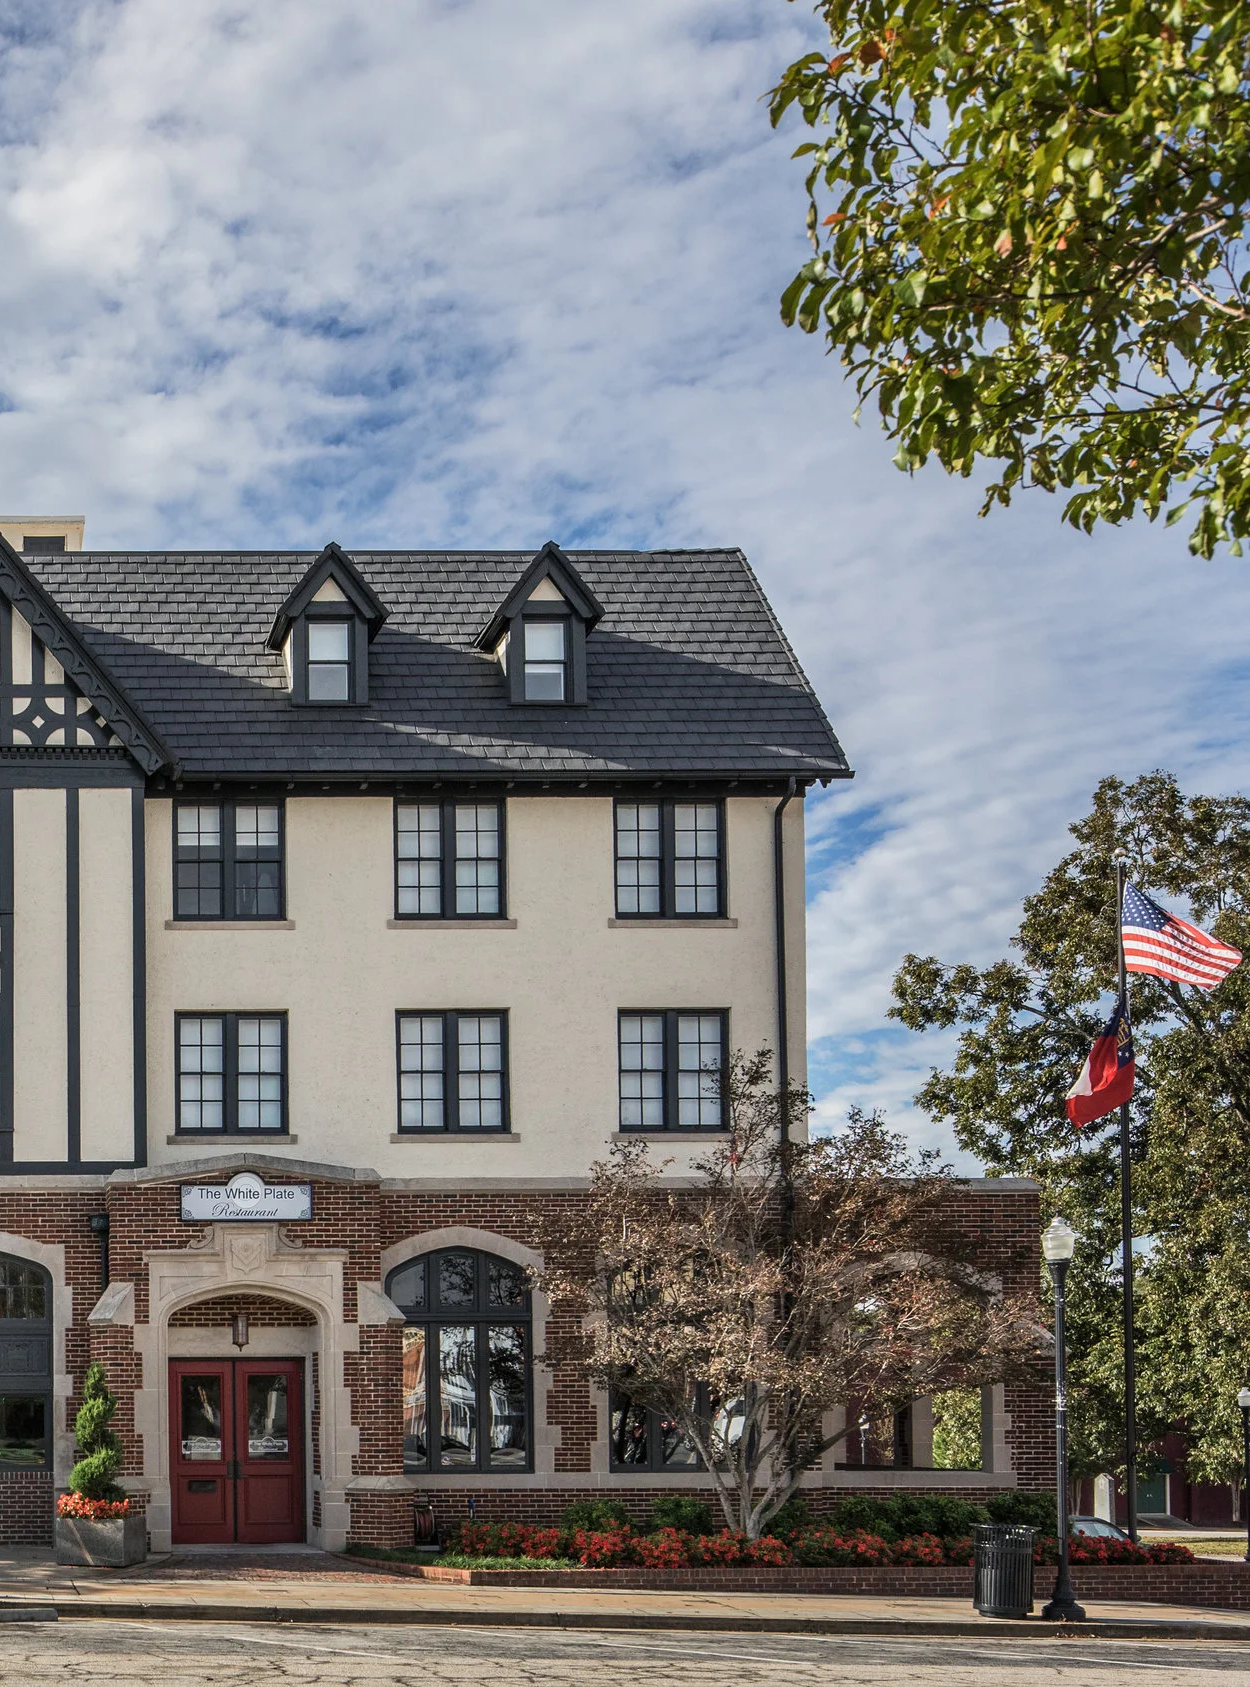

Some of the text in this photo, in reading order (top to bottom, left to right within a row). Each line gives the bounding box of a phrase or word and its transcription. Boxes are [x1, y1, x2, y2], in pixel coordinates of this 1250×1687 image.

[198, 1188, 295, 1199] The White Plate
[211, 1202, 278, 1217] Restaurant
